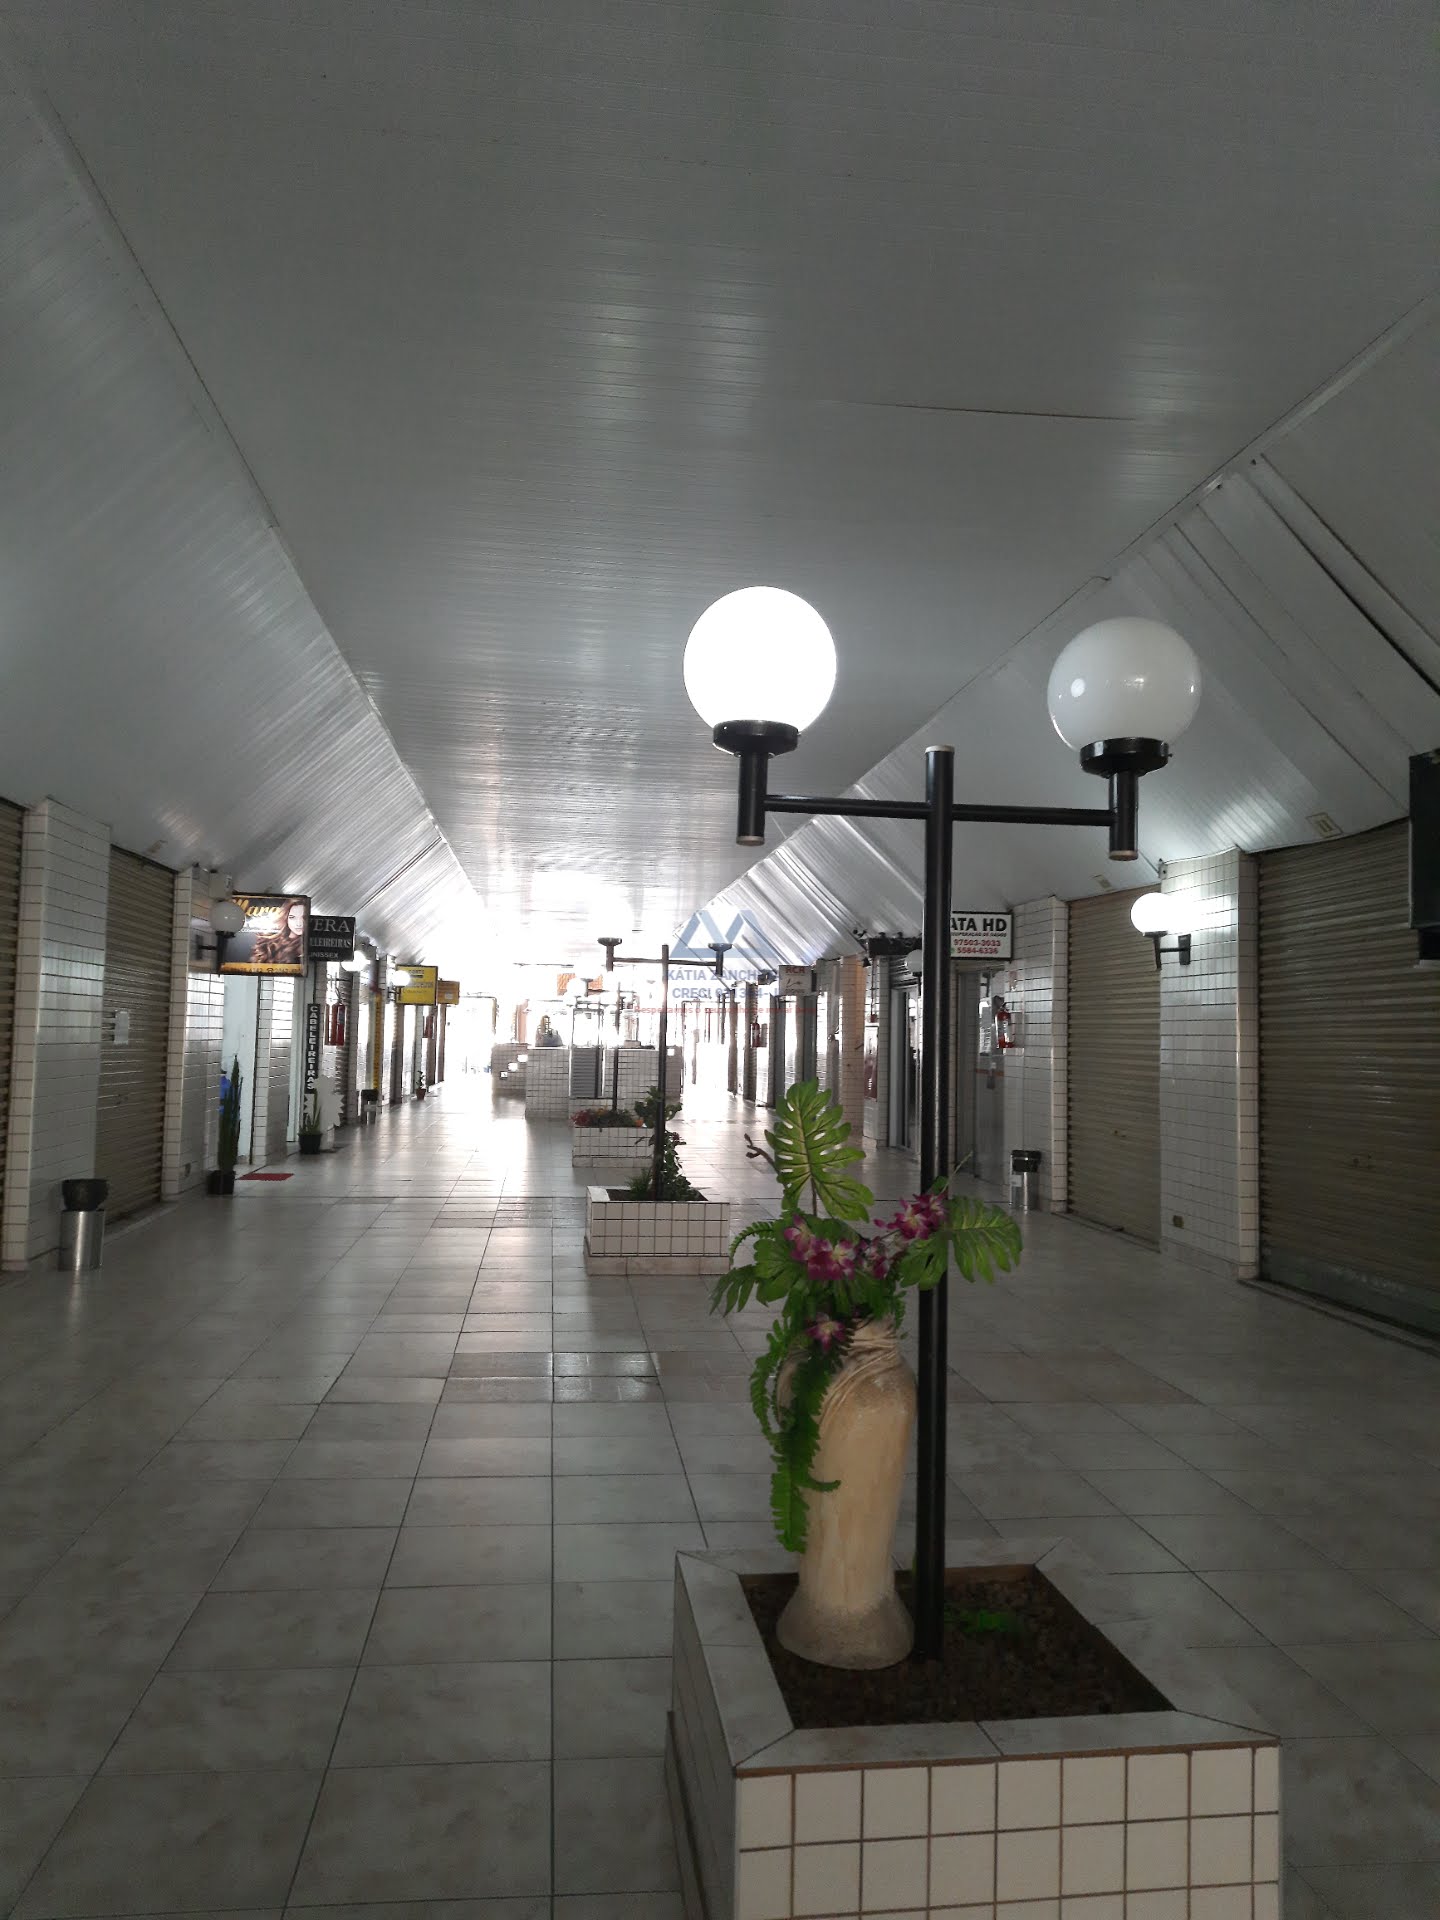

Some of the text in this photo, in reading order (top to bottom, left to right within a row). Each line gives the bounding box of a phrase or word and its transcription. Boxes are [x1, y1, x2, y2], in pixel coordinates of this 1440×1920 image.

[310, 918, 351, 933] ERA
[951, 917, 1007, 931] ATA HD
[306, 1005, 318, 1090] CABELEIREIRAS
